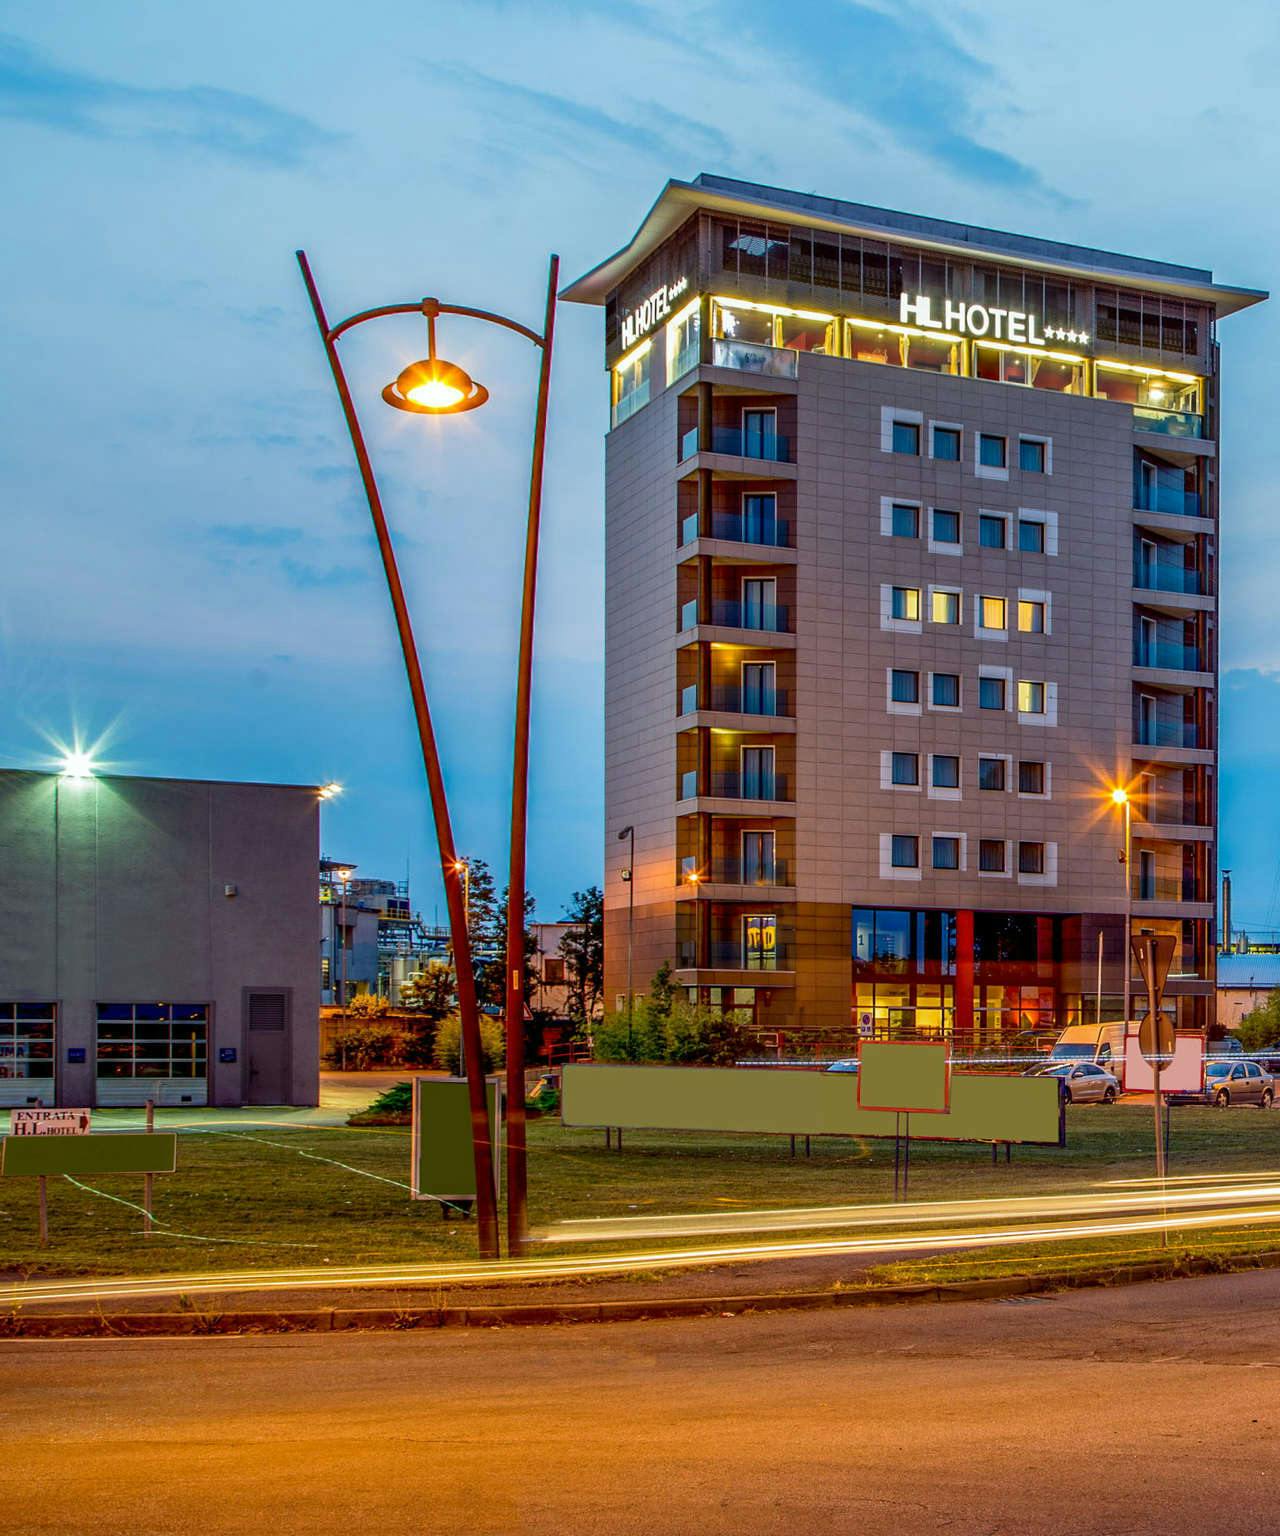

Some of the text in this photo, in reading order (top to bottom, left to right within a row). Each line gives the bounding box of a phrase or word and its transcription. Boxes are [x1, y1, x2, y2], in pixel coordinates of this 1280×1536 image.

[635, 284, 670, 337] HOTEL
[945, 300, 1045, 345] HOTEL
[17, 1111, 75, 1121] ENTRATA
[46, 1126, 78, 1136] HOTEL
